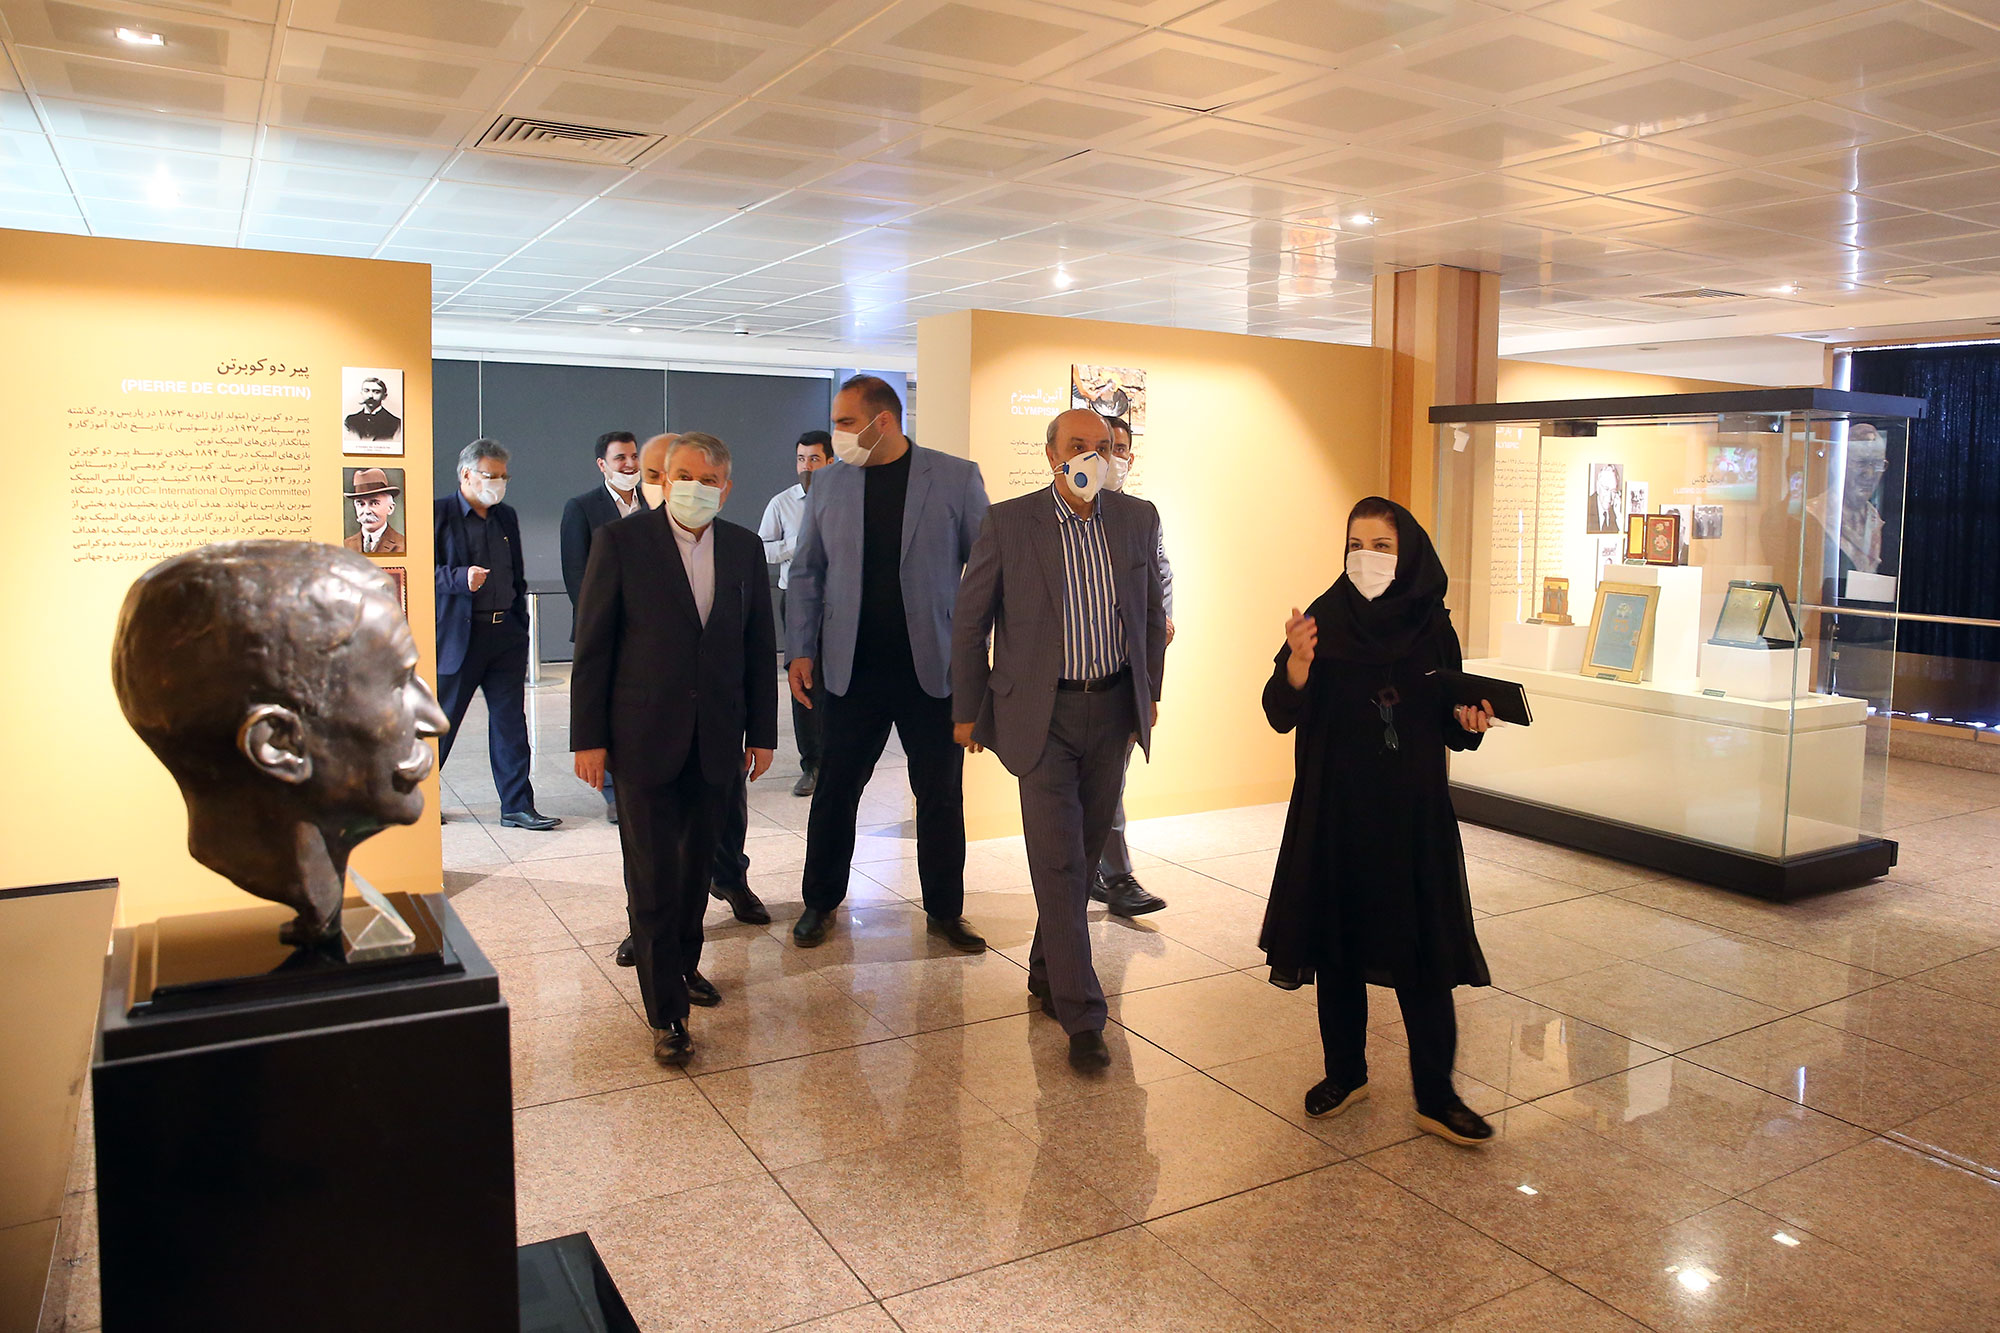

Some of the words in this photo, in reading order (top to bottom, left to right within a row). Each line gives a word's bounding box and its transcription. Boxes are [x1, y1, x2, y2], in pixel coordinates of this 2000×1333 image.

[217, 358, 268, 376] کوبرتن
[269, 363, 286, 376] دو
[288, 366, 310, 379] پیر
[121, 378, 187, 394] (PIERRE
[192, 382, 213, 394] DE
[217, 382, 312, 401] COUBERTIN)
[1010, 406, 1060, 416] OLYMPISM
[70, 486, 102, 495] دانشگاه
[106, 488, 115, 496] در
[118, 486, 124, 496] را
[159, 486, 218, 495] International
[220, 487, 257, 497] Olympic
